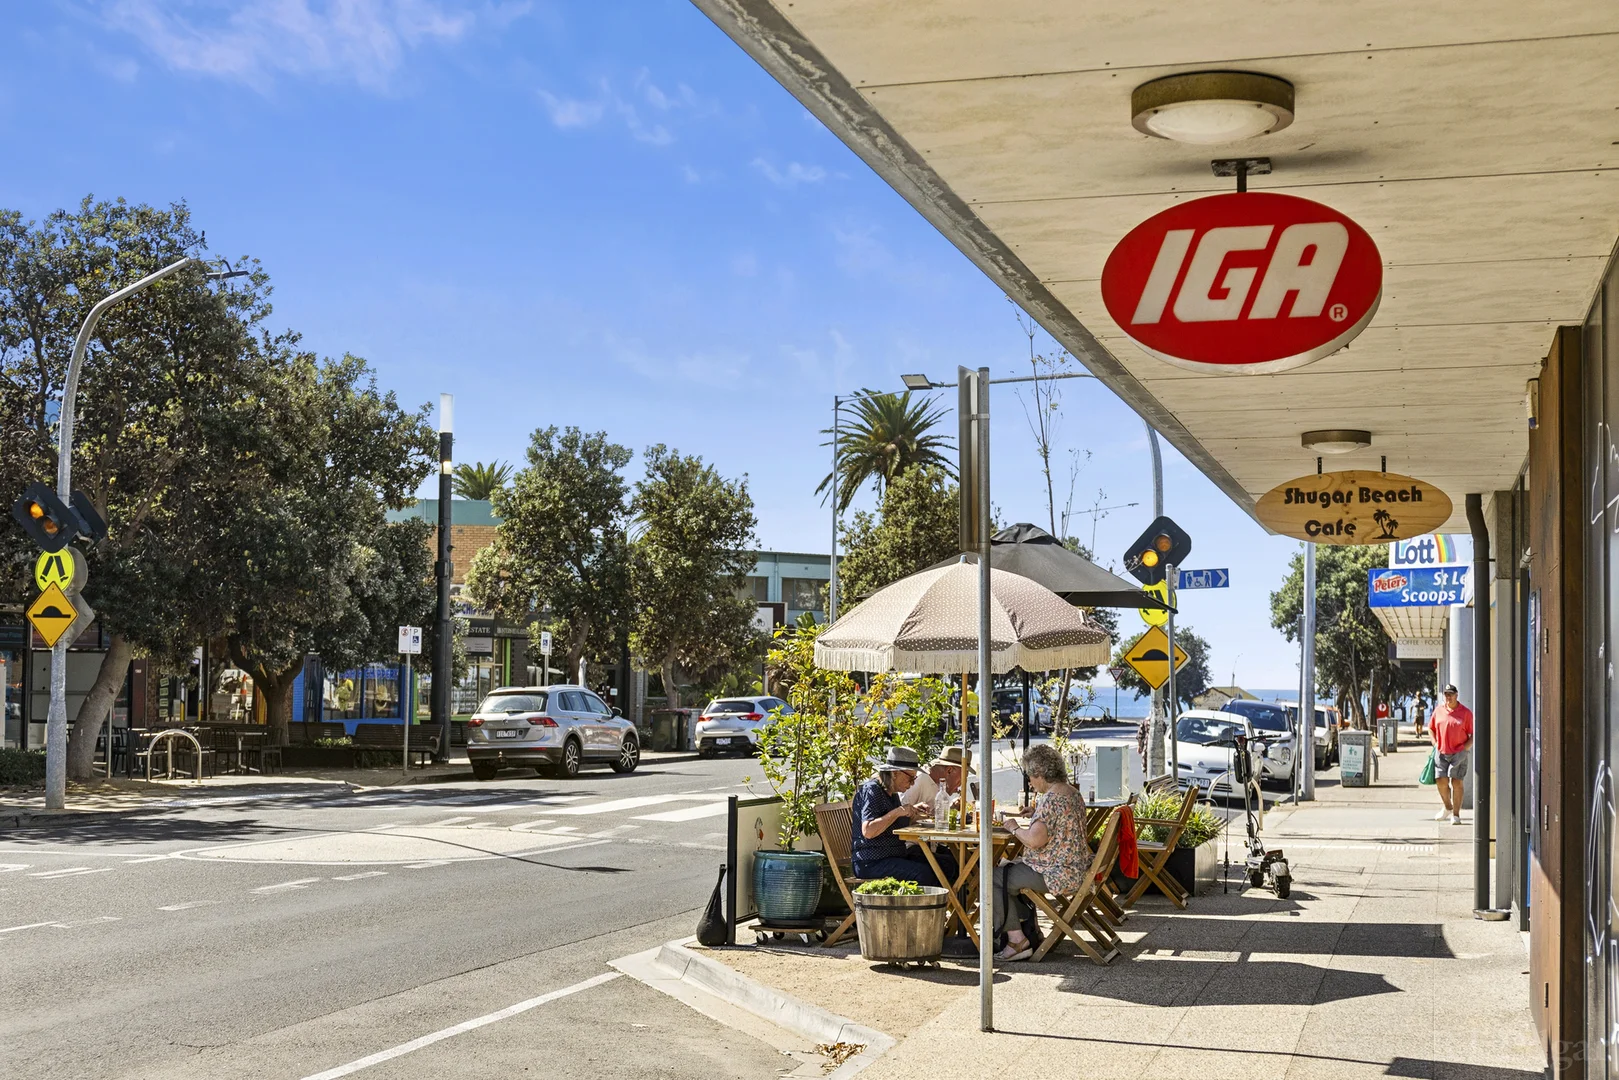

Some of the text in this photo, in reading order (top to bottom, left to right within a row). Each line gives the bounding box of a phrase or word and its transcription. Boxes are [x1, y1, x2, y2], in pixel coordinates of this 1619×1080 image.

[1131, 221, 1349, 325] IGA
[1284, 485, 1423, 509] Shugar Beach
[1304, 519, 1357, 537] Cafe
[1395, 539, 1435, 565] Lott
[1373, 576, 1407, 592] Peters
[1433, 571, 1449, 586] St
[1401, 588, 1456, 605] Scoops
[470, 626, 491, 634] STATE
